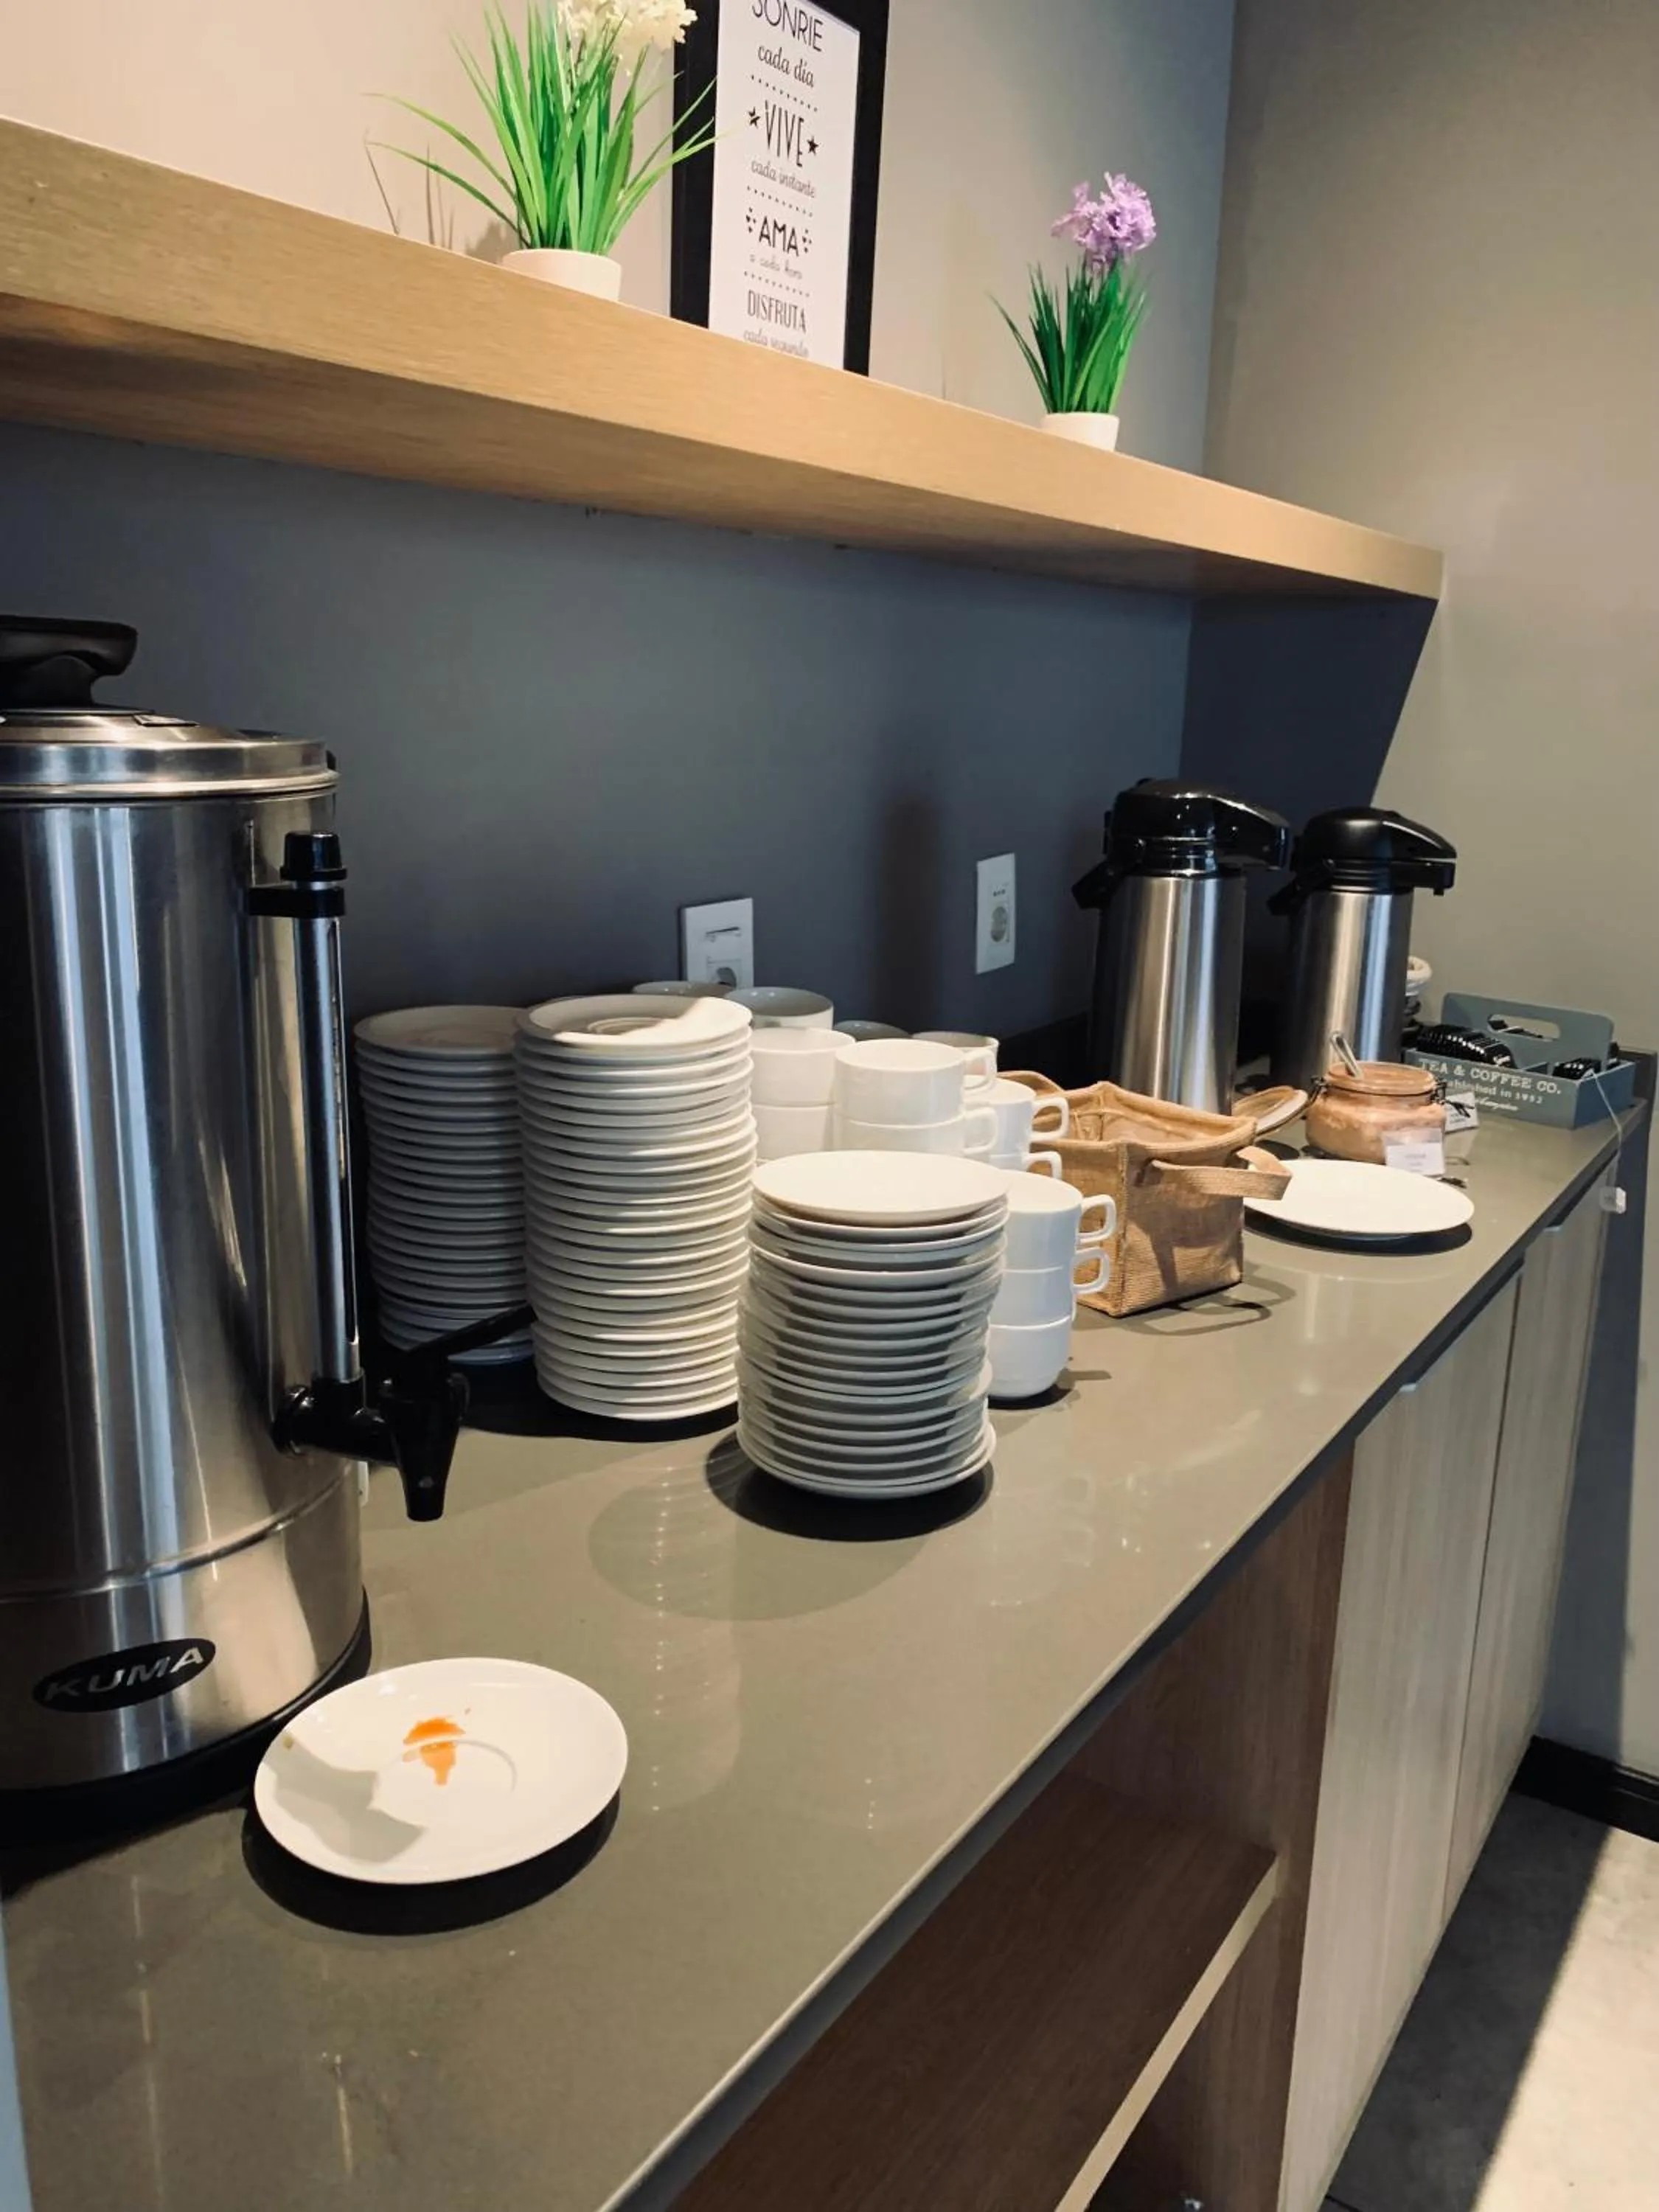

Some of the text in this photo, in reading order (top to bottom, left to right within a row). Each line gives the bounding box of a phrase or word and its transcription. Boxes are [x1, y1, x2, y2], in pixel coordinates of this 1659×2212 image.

[758, 46, 790, 74] cada
[765, 100, 804, 167] VIVE
[759, 216, 799, 257] AMA
[747, 289, 807, 334] DISFRUTA
[1453, 1064, 1466, 1076] &
[1470, 1067, 1531, 1089] COFFEE
[1537, 1079, 1562, 1094] CO.
[45, 1646, 205, 1701] KUMA
